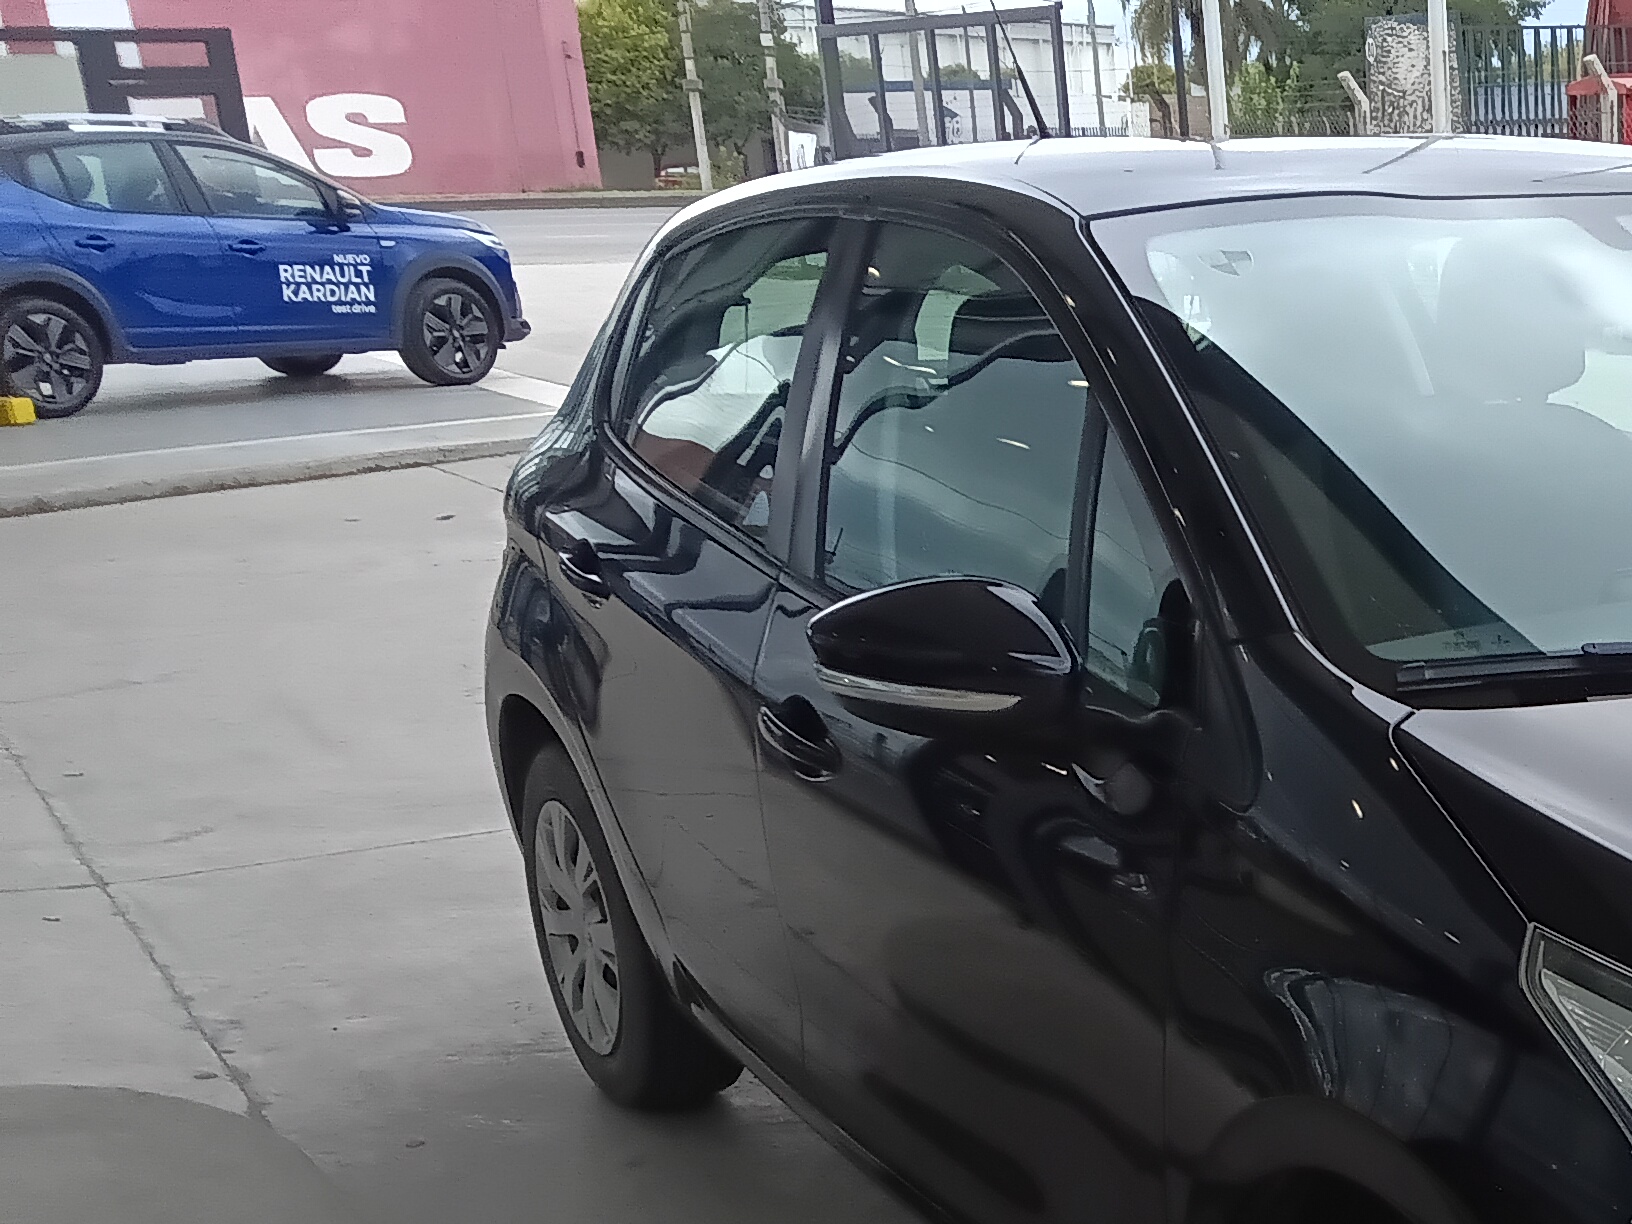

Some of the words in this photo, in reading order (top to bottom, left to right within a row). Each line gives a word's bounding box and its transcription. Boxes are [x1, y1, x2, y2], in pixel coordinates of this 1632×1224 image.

[333, 254, 371, 264] NUEVO
[278, 265, 372, 283] RENAULT
[282, 284, 376, 302] KARDIAN
[331, 304, 351, 313] test
[352, 303, 376, 313] drive
